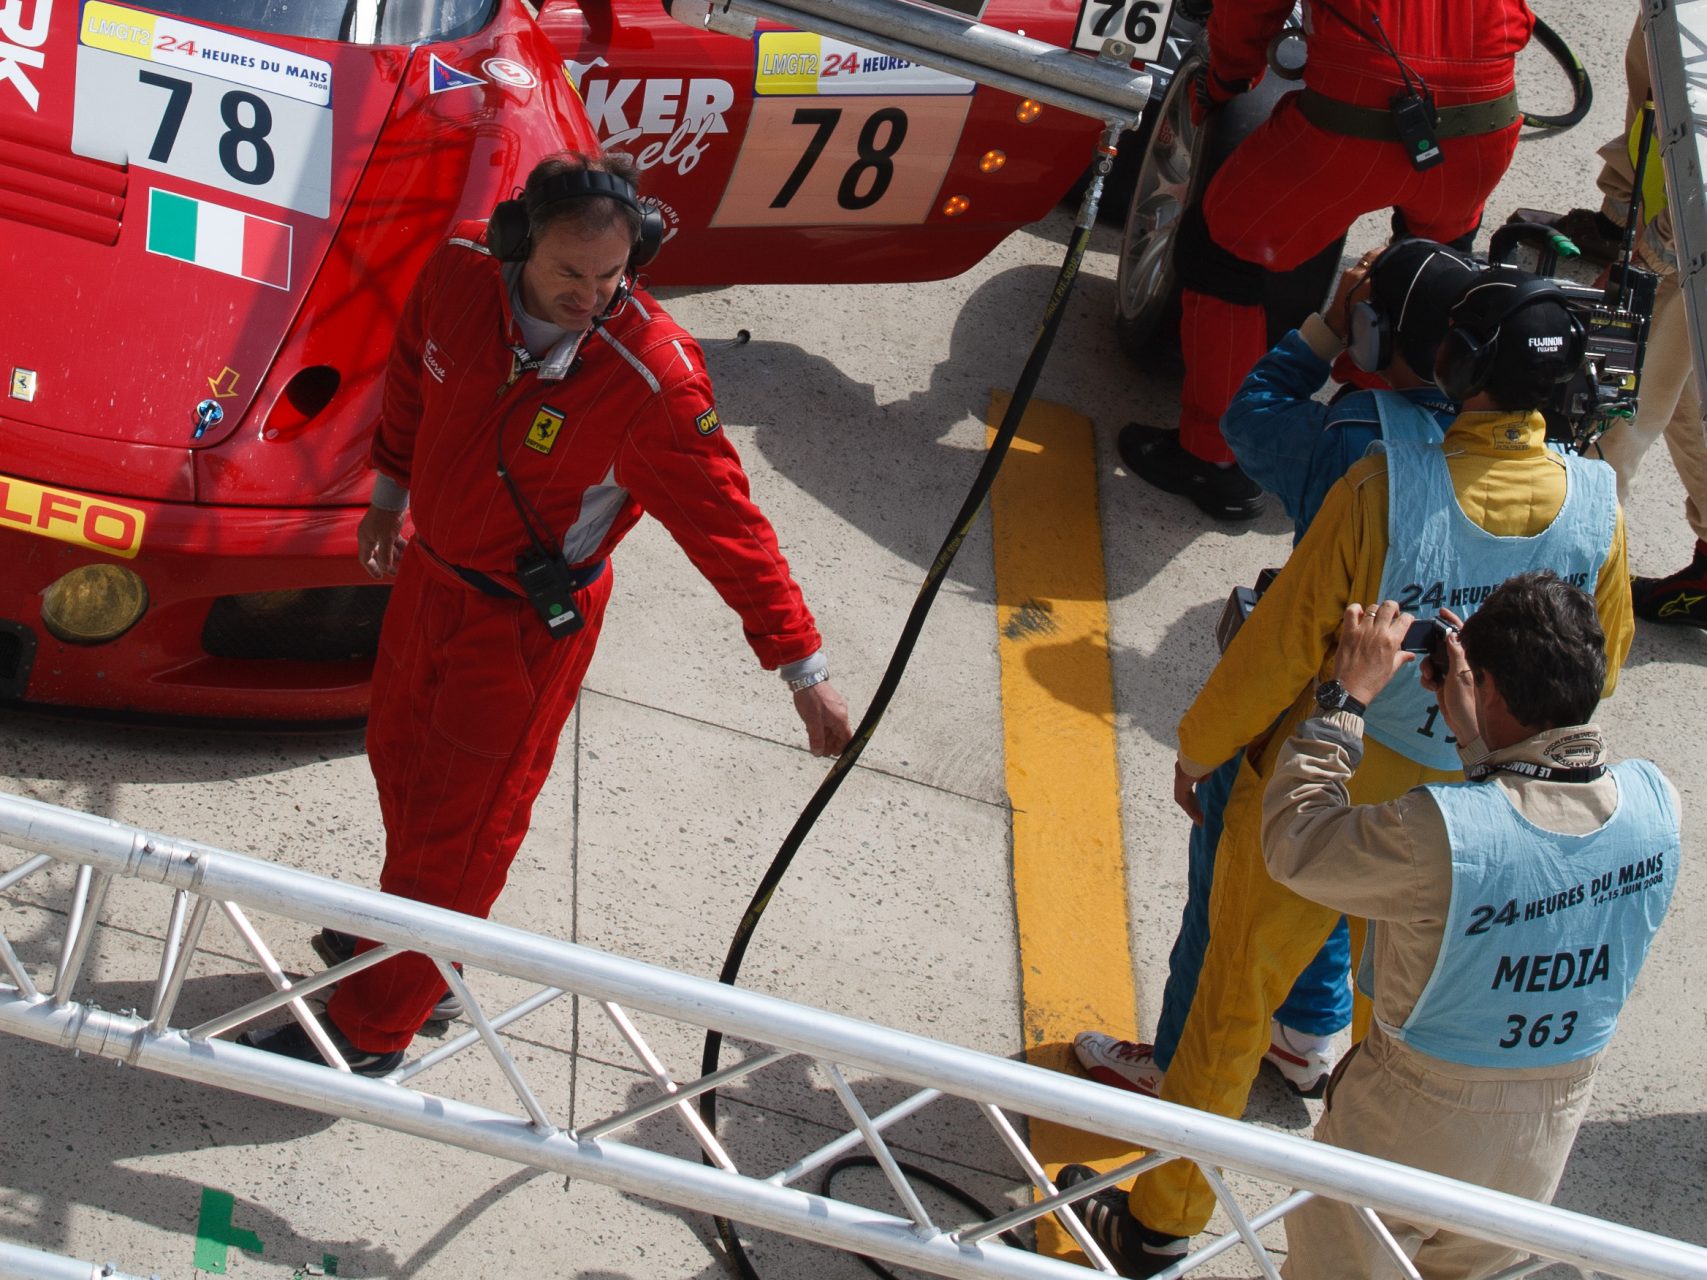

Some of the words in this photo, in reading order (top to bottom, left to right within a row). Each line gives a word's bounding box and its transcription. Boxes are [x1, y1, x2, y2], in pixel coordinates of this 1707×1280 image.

[88, 16, 151, 46] LMGT2
[155, 34, 198, 57] 24
[201, 48, 256, 69] HEURES
[260, 59, 280, 73] DU
[285, 65, 328, 84] MANS
[762, 53, 819, 76] LMGT2
[820, 51, 860, 78] 24
[308, 81, 329, 91] 2008
[138, 69, 275, 186] 78
[768, 106, 909, 211] 78
[1528, 336, 1563, 347] FUJINON
[700, 410, 720, 432] OM
[1400, 581, 1447, 612] 24
[1465, 897, 1520, 936] 24
[1524, 883, 1585, 922] HEURES
[1591, 871, 1613, 898] DU
[1617, 851, 1664, 887] MANS
[1593, 891, 1618, 908] 14-15
[1620, 882, 1641, 897] JUIN
[1643, 872, 1664, 889] 2008
[1490, 943, 1610, 993] MEDIA
[1498, 1010, 1578, 1049] 363
